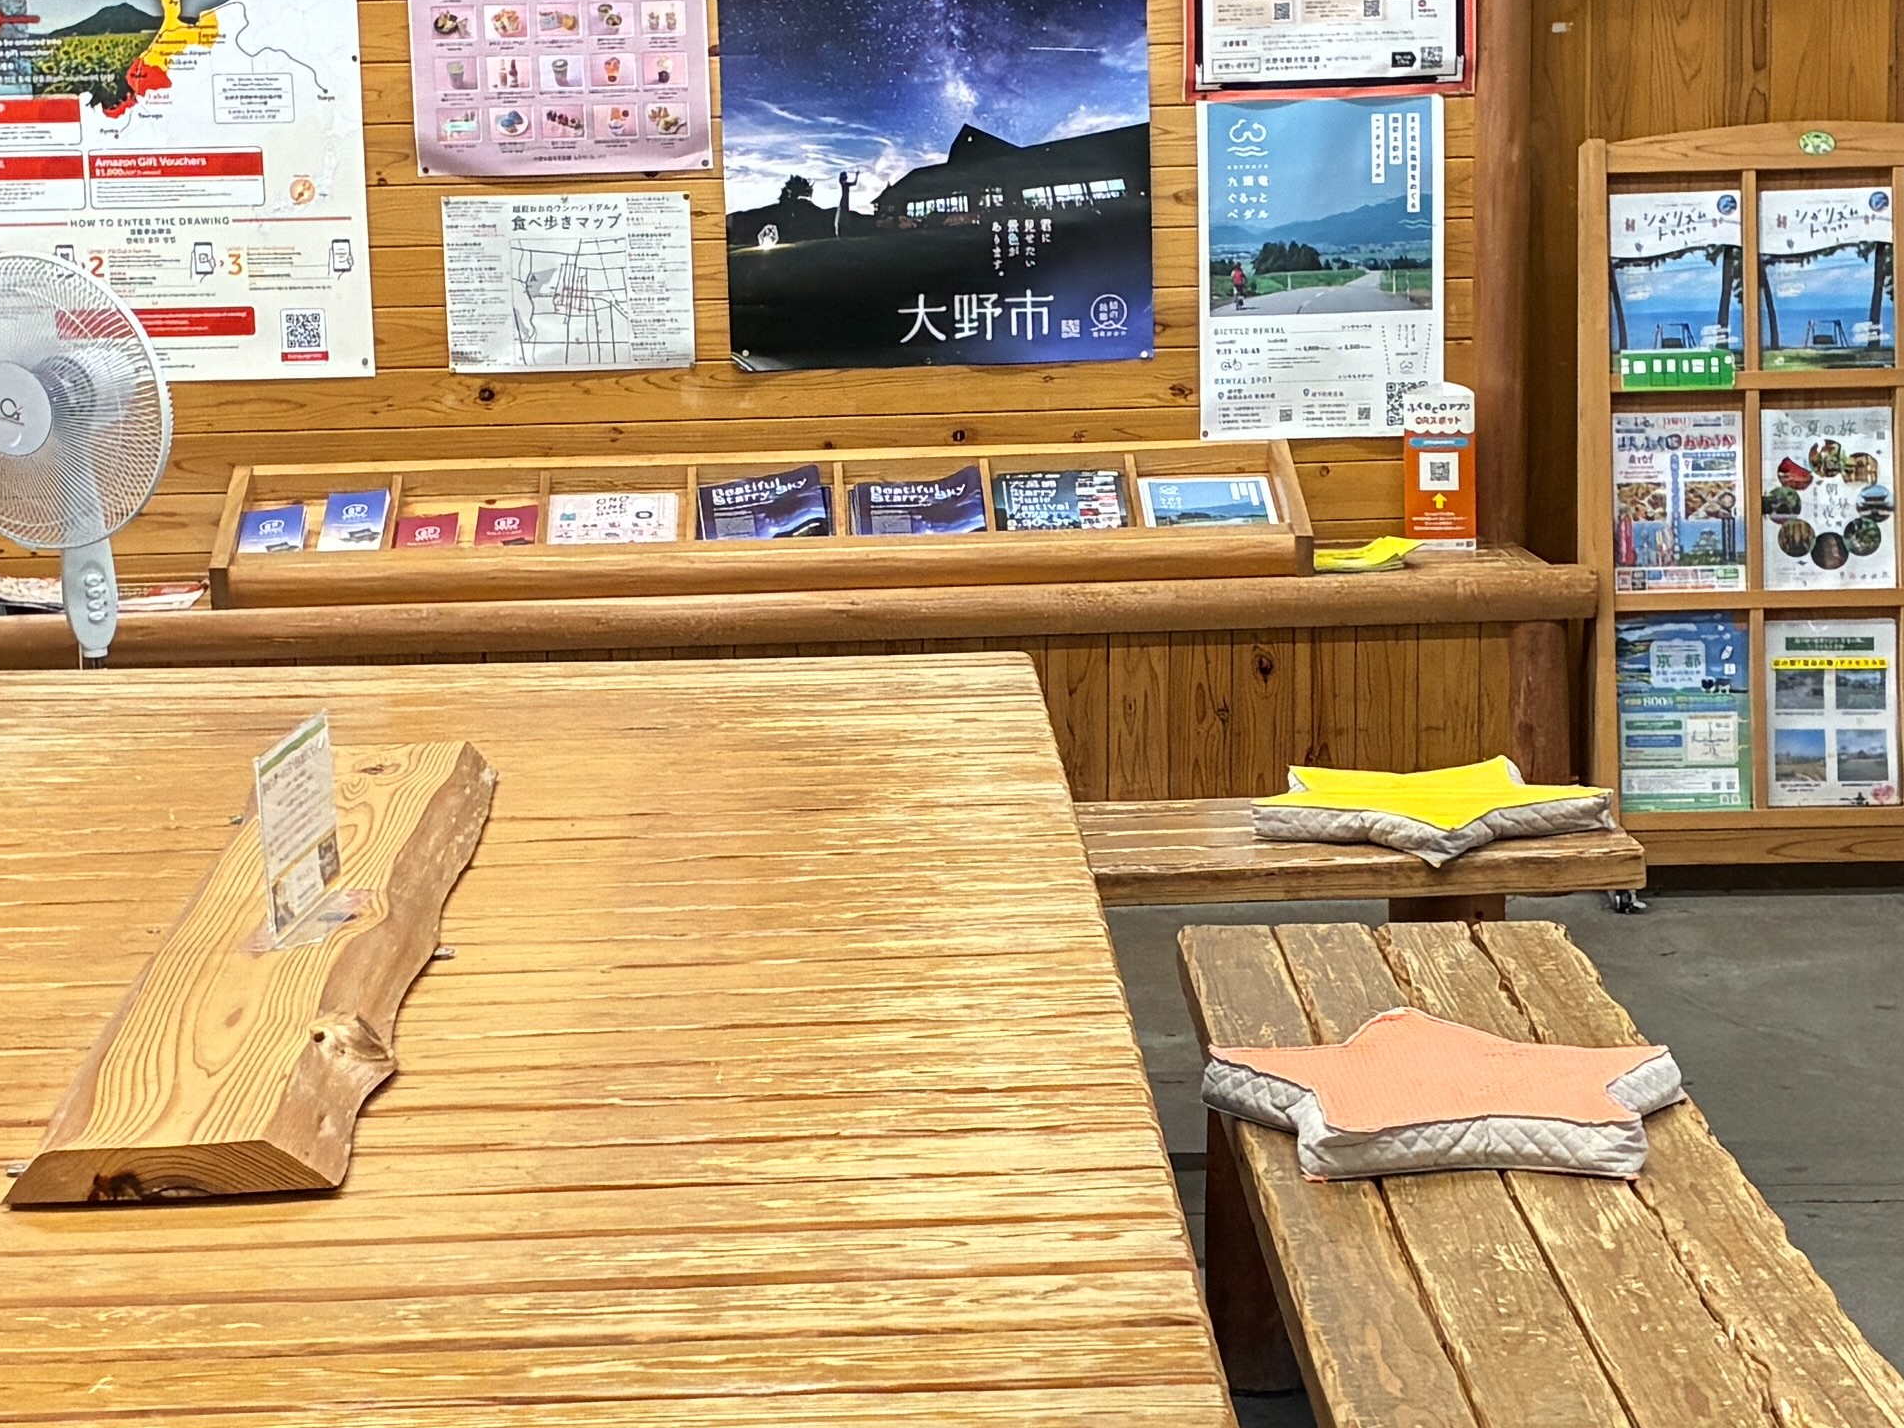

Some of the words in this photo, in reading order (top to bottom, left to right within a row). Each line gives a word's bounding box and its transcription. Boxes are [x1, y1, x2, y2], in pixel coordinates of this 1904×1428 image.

[95, 156, 136, 168] Amazon
[138, 156, 157, 167] Gift
[159, 155, 207, 167] Vouchers
[1227, 192, 1269, 205] ぐるっと
[1226, 208, 1269, 221] ペダル
[70, 219, 96, 228] HOW
[98, 219, 114, 228] TO
[117, 218, 152, 227] ENTER
[155, 218, 177, 227] THE
[179, 216, 230, 226] DRAWING
[512, 213, 623, 232] 食べ歩きマップ
[1024, 219, 1036, 268] 見せたい
[90, 256, 105, 278] 2
[228, 254, 243, 276] 3
[897, 288, 1054, 343] 大野市
[1011, 488, 1057, 498] Starry
[1012, 496, 1052, 504] Music
[1012, 502, 1071, 512] Festival
